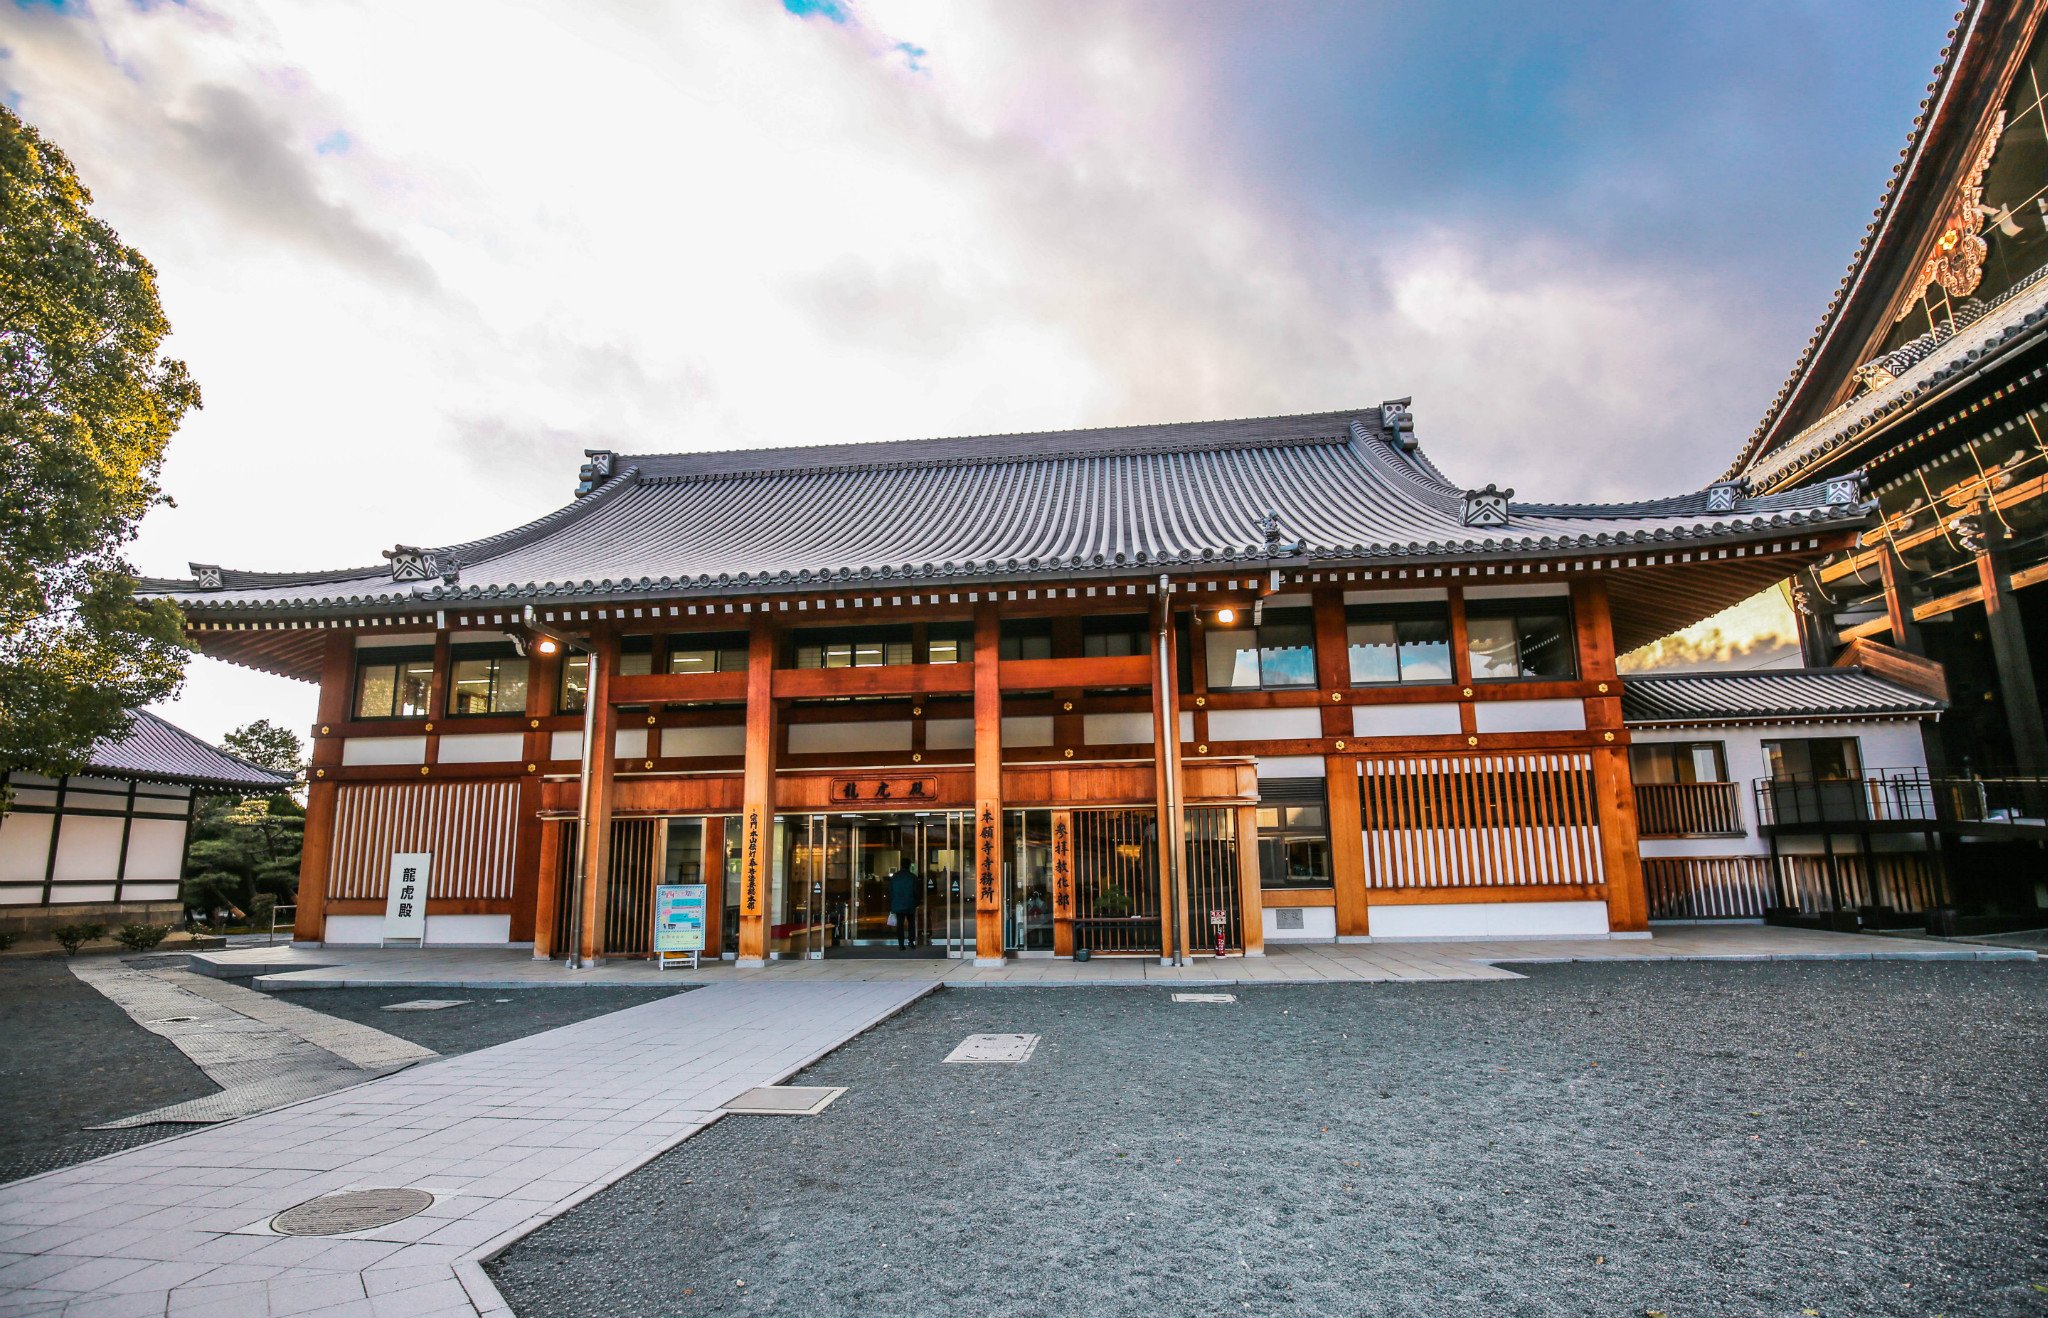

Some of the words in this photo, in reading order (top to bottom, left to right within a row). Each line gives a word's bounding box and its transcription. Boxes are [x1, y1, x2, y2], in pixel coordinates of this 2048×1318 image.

[398, 867, 417, 918] 龍虎殿
[979, 809, 995, 904] 本願寺寺務所
